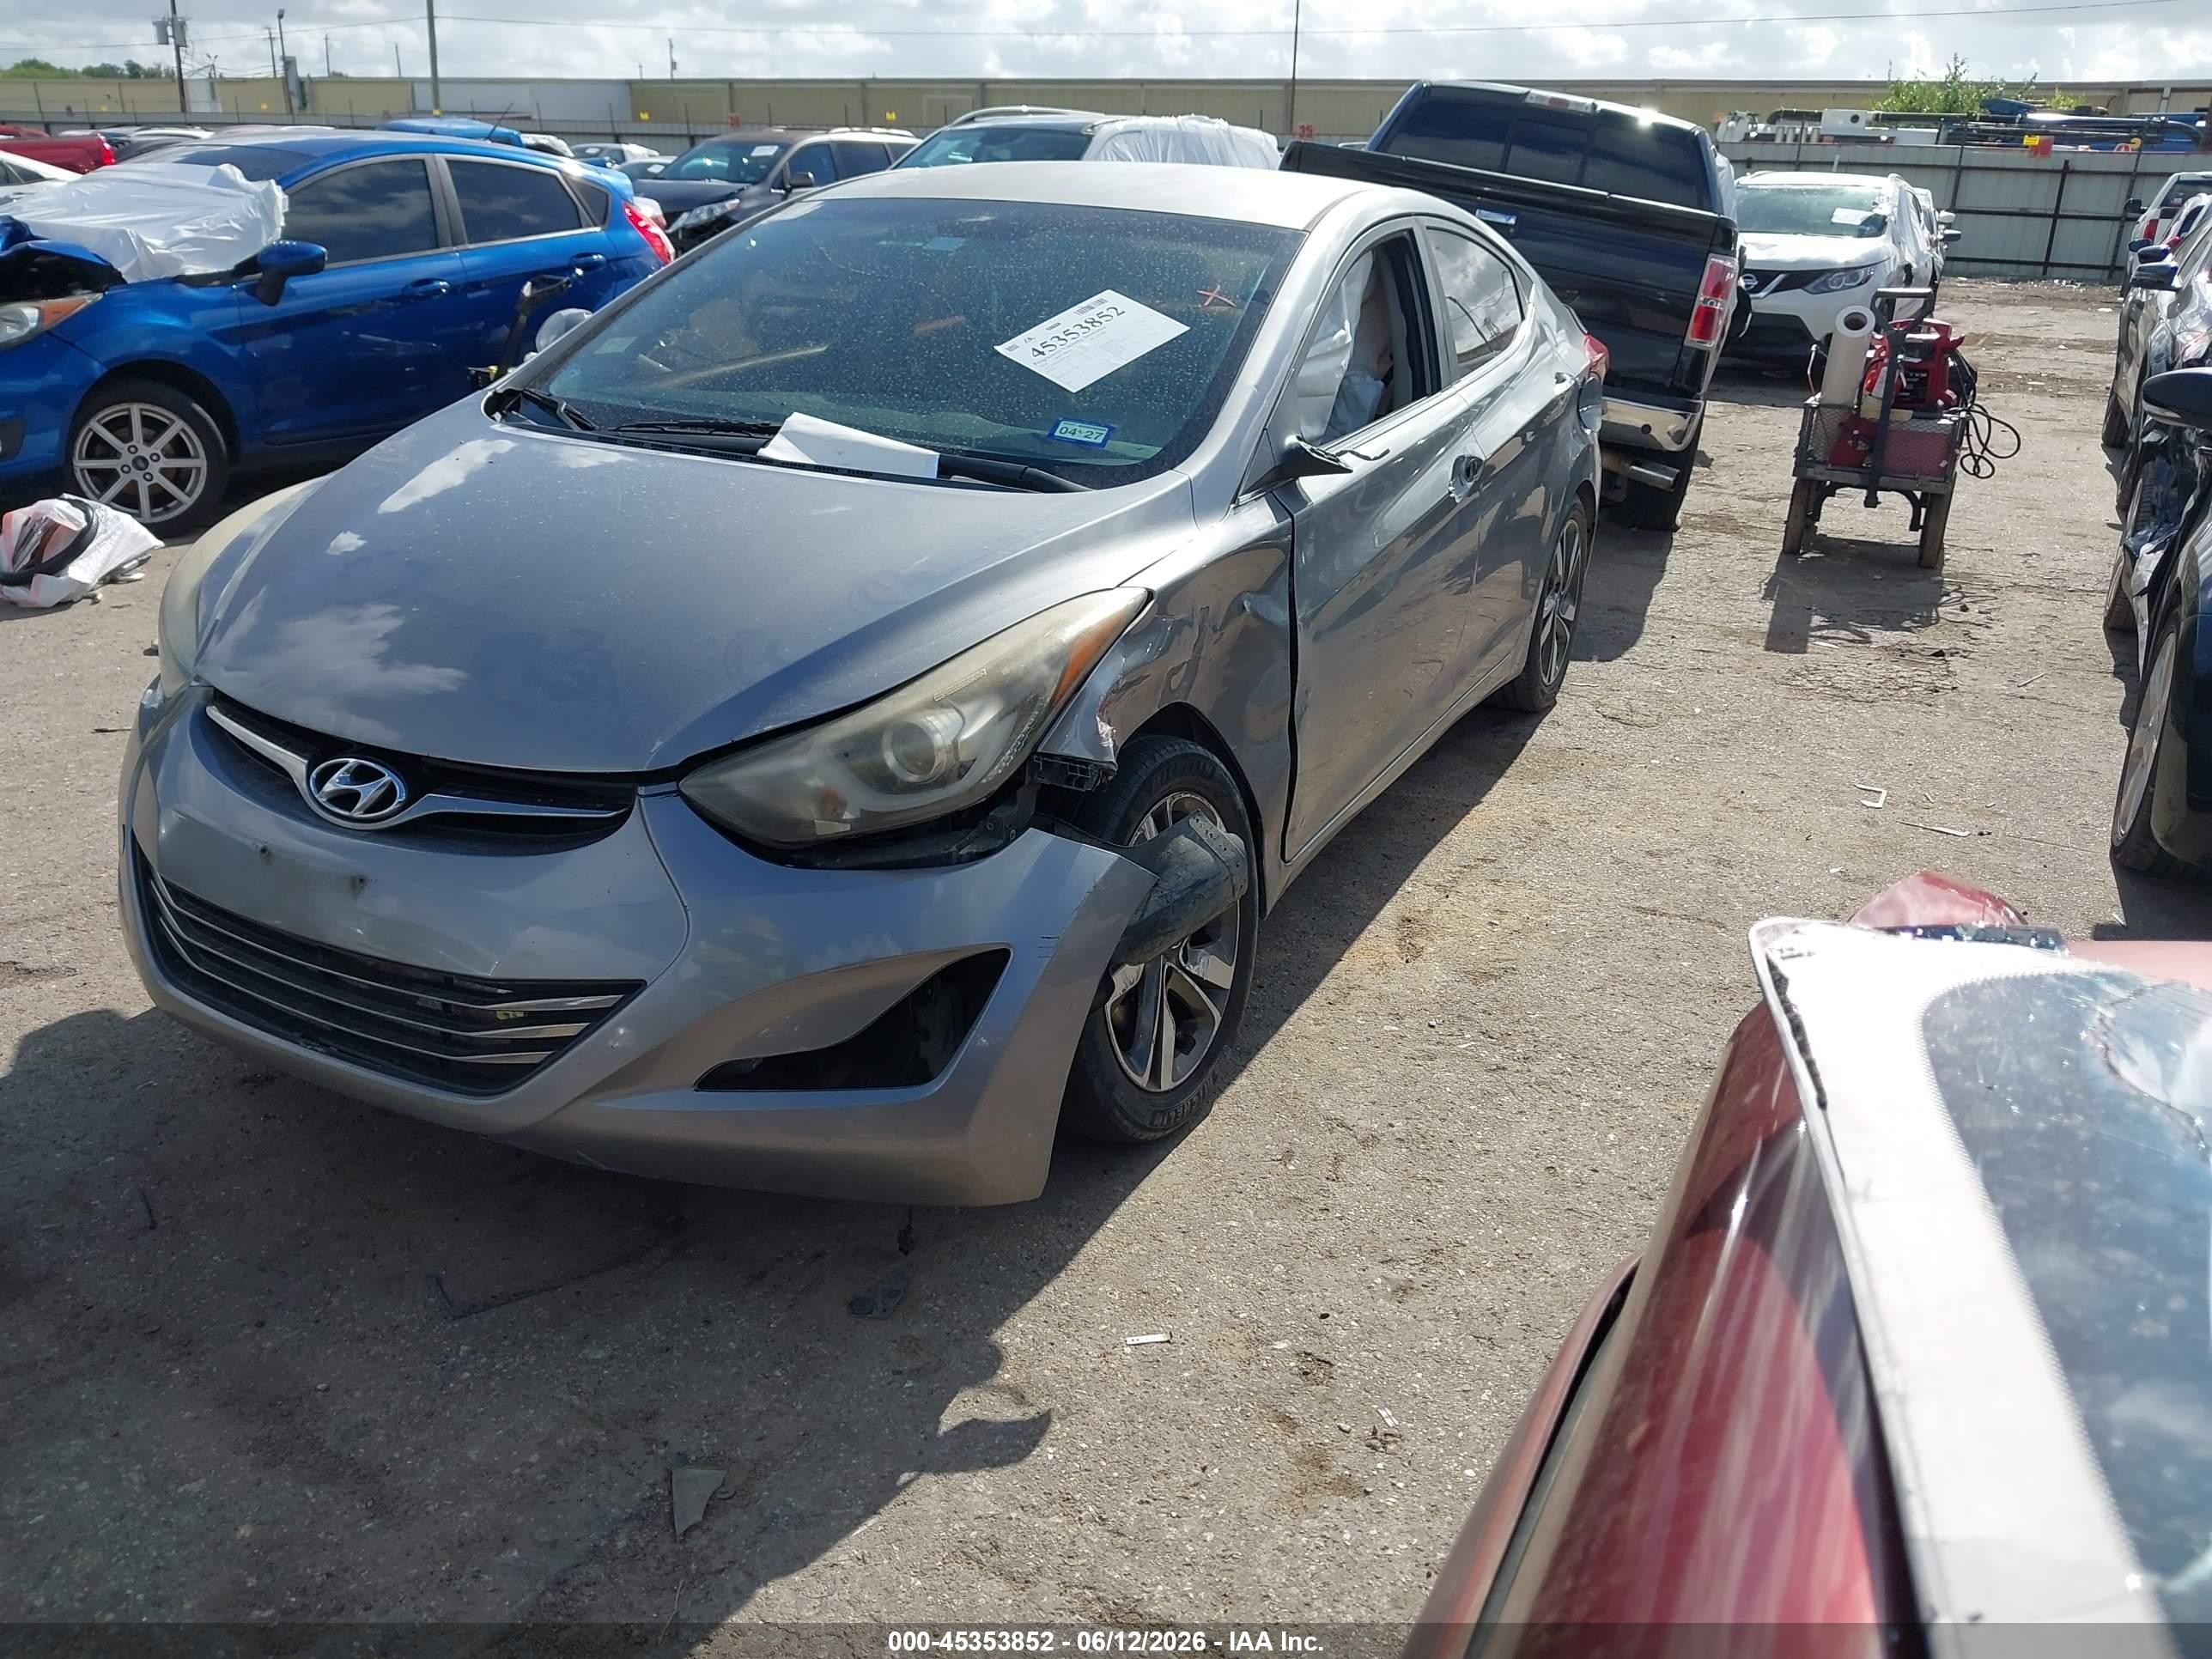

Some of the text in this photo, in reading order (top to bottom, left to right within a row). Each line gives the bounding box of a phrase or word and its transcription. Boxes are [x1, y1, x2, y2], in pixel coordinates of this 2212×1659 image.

[1031, 307, 1126, 357] 45353852
[1059, 427, 1078, 435] 04
[1084, 431, 1104, 440] 27
